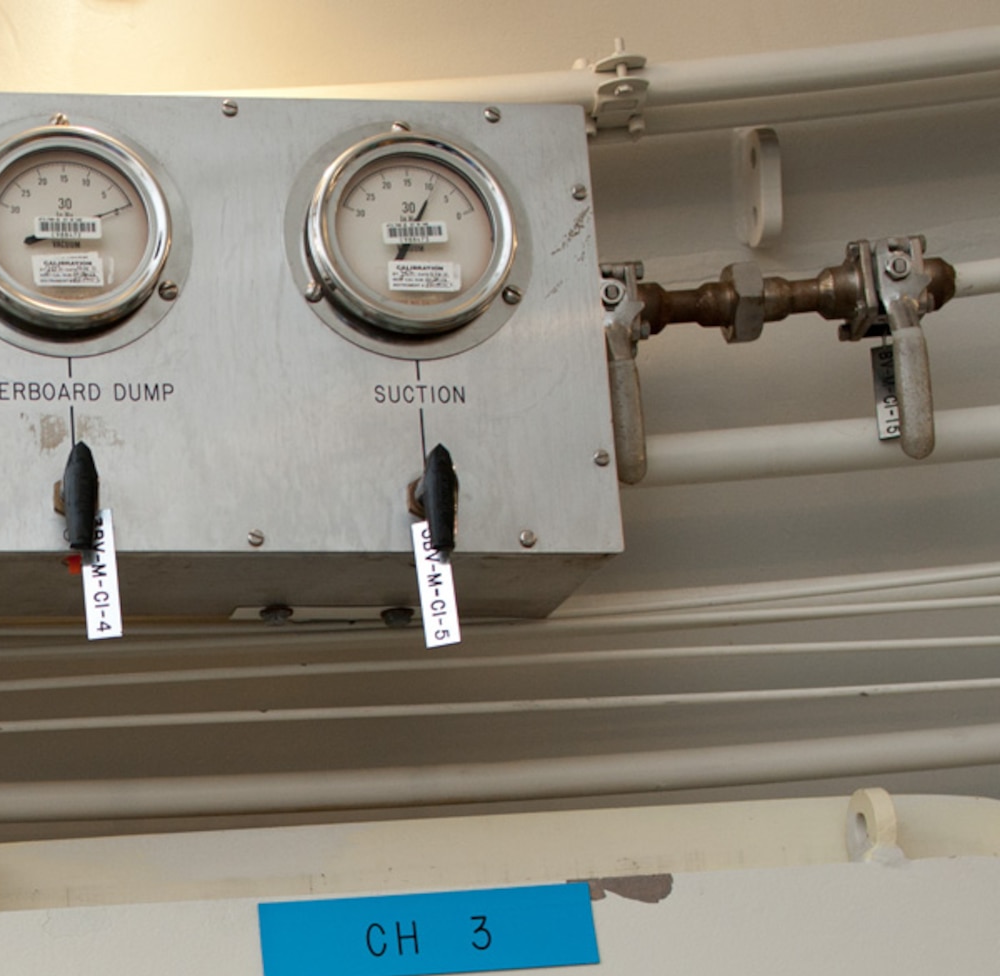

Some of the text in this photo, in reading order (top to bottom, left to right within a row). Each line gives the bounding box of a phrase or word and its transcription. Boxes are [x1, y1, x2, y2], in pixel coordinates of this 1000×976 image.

[38, 177, 47, 186] 20
[60, 175, 68, 183] 15
[82, 178, 90, 187] 10
[403, 179, 411, 187] 15
[382, 181, 391, 190] 20
[424, 182, 433, 191] 10
[21, 189, 30, 197] 25
[366, 192, 375, 201] 25
[58, 198, 72, 210] 30
[402, 202, 415, 213] 30
[11, 205, 20, 214] 30
[356, 208, 365, 217] 30
[456, 212, 462, 220] 0
[53, 240, 80, 249] VACUUM
[114, 383, 174, 402] DUMP
[374, 385, 465, 404] SUCTION
[366, 915, 492, 957] CH 3
